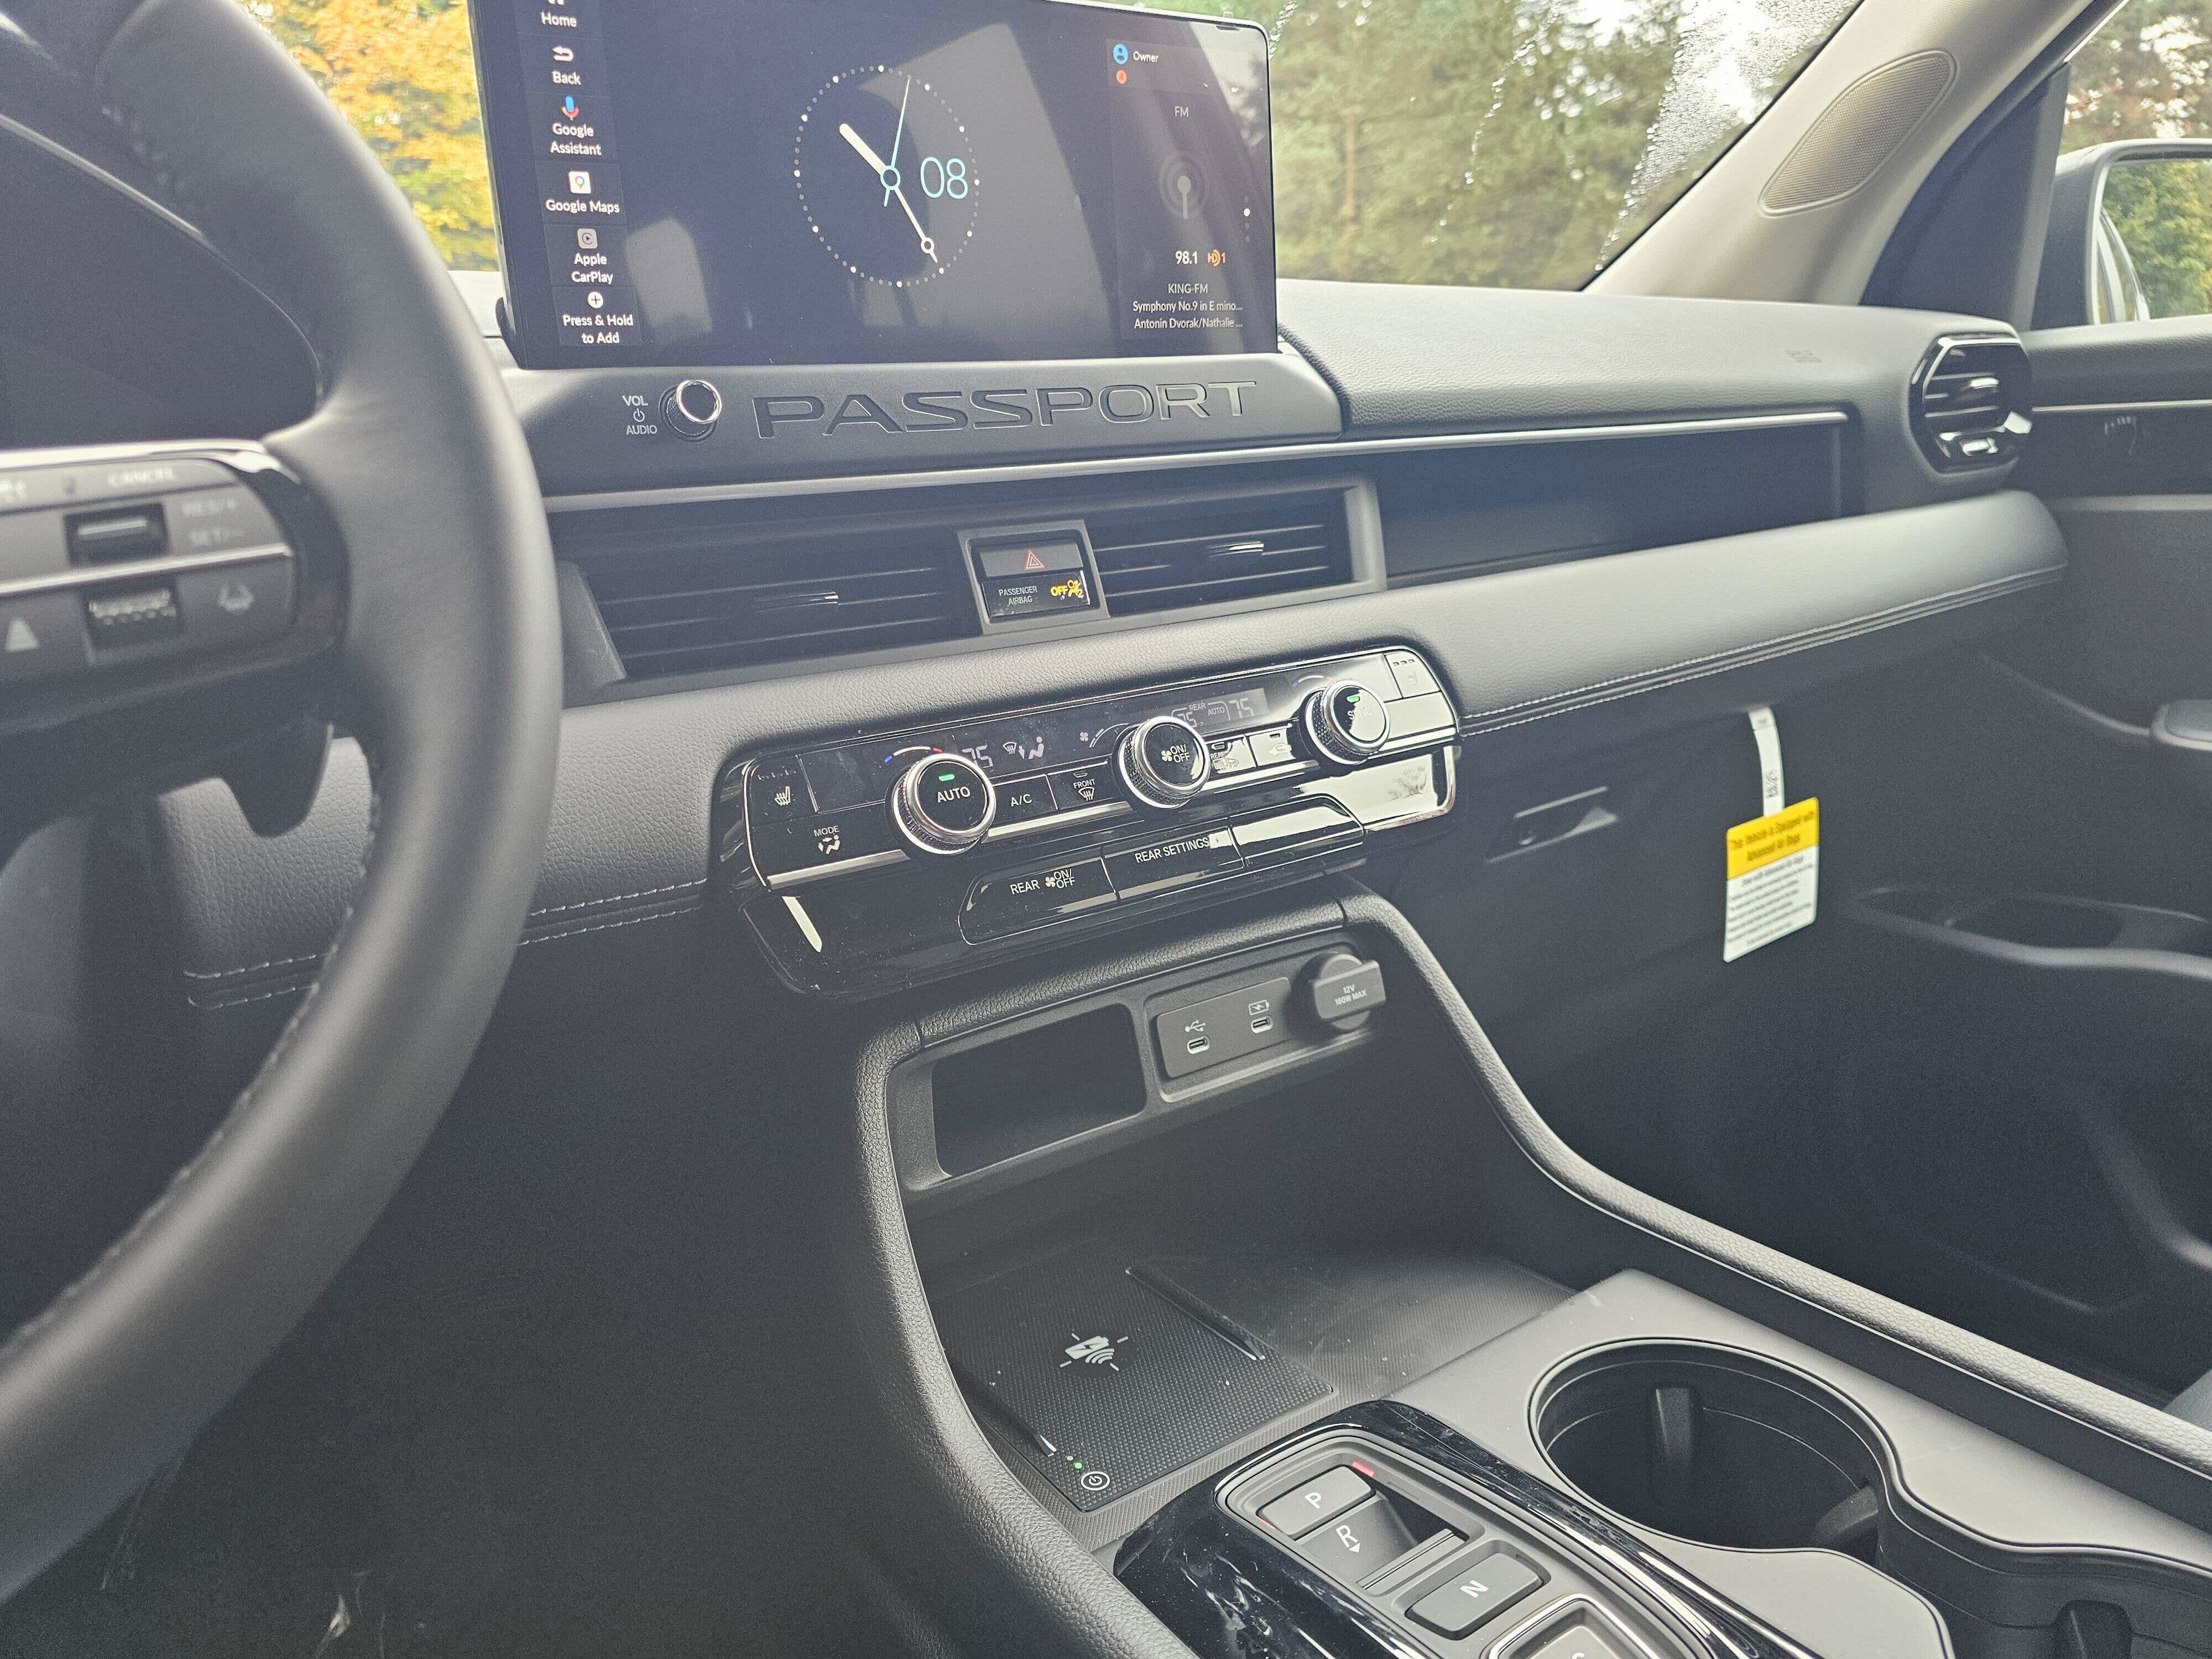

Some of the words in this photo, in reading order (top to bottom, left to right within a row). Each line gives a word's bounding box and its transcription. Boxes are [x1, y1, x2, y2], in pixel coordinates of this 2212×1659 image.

[541, 11, 577, 27] Home
[1133, 51, 1159, 63] Owner
[552, 70, 581, 85] Back
[1175, 106, 1189, 117] FM
[552, 123, 594, 138] Google
[550, 140, 602, 156] Assistant
[920, 156, 968, 199] 08
[546, 199, 587, 213] Google
[589, 200, 620, 213] Maps
[574, 253, 607, 267] Apple
[1175, 250, 1198, 265] 98.1
[571, 272, 613, 284] CarPlay
[1168, 283, 1208, 294] KING-FM
[1133, 300, 1177, 314] Symphony
[1178, 300, 1198, 311] No.9
[1199, 300, 1207, 311] in
[1209, 300, 1215, 311] E
[563, 314, 593, 326] Press
[595, 315, 605, 326] &
[607, 314, 634, 326] Hold
[1134, 317, 1167, 329] Antonin
[581, 333, 594, 344] to
[597, 332, 620, 344] Add
[622, 395, 648, 406] VOL
[752, 381, 1257, 439] PASSPORT
[626, 425, 658, 435] AUDIO
[998, 586, 1038, 597] PASSENGER
[1051, 585, 1068, 597] OFF
[1008, 596, 1033, 606] AIRBAG
[1189, 702, 1207, 711] REAR
[1208, 707, 1225, 716] AUTO
[1228, 697, 1255, 719] 75
[1347, 707, 1373, 721] SYNC
[1170, 744, 1187, 754] ON/
[962, 744, 994, 770] 75
[1173, 753, 1190, 763] OFF
[1073, 778, 1095, 789] FRONT
[937, 786, 971, 803] AUTO
[1010, 794, 1032, 807] A/C
[813, 826, 840, 837] MODE
[1135, 848, 1162, 863] REAR
[1164, 836, 1209, 857] SETTINGS
[1010, 879, 1040, 895] REAR
[1053, 869, 1073, 880] ON/
[1056, 877, 1076, 889] OFF
[1343, 984, 1355, 994] 12V
[1352, 989, 1368, 1000] MAX
[1304, 1492, 1322, 1509] P
[1335, 1524, 1358, 1548] R
[1459, 1579, 1489, 1598] N
